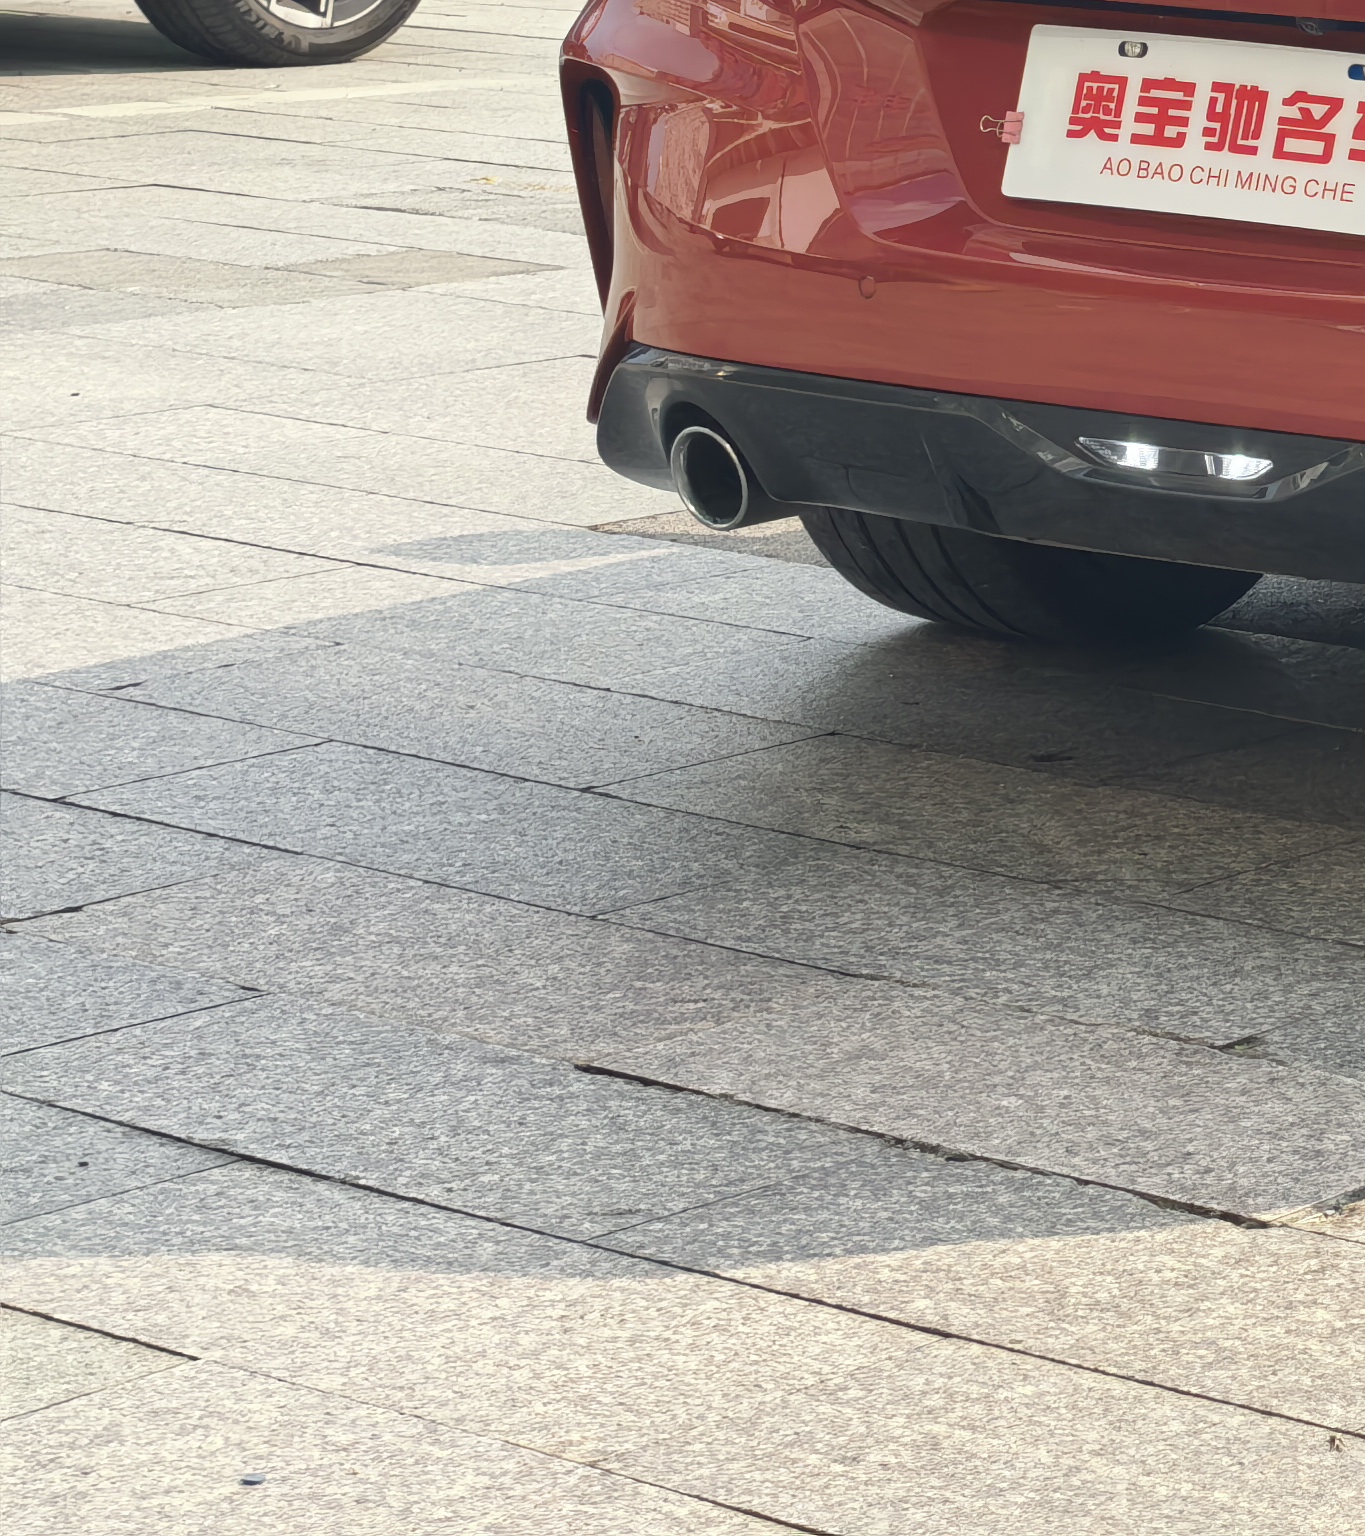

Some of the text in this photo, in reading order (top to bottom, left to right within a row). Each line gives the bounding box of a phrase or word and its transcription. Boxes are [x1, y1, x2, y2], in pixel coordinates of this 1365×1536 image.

[1099, 156, 1356, 203] AO BAO CHI MING CHE
